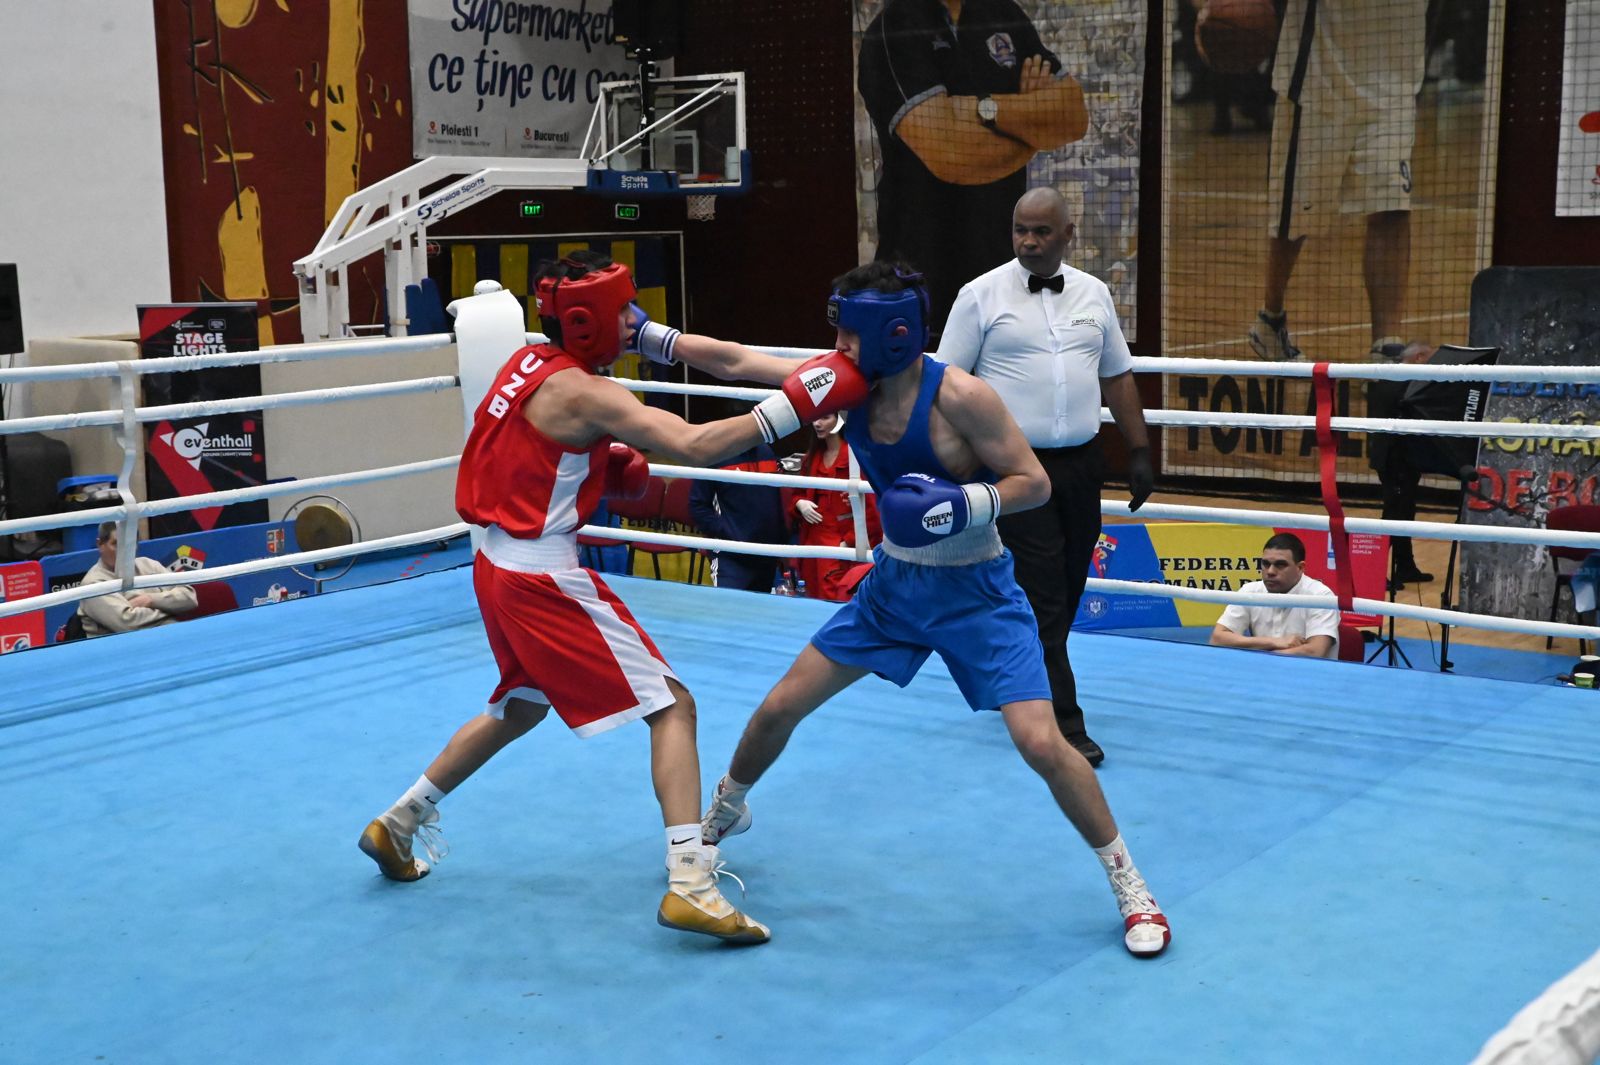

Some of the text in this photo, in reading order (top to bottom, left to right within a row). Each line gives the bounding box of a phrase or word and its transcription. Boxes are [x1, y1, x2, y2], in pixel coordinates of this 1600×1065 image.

[428, 53, 464, 92] ce
[474, 49, 533, 112] ține
[542, 65, 576, 103] cu
[461, 177, 485, 193] Sports
[524, 205, 541, 215] EXIT
[175, 333, 224, 344] STAGE
[173, 344, 227, 356] LIGHTS
[804, 370, 834, 387] GREEN
[807, 378, 833, 393] HILL
[1179, 374, 1285, 455] TONI
[184, 434, 252, 448] eventhall
[1466, 466, 1535, 513] DE
[923, 512, 952, 522] GREEN
[926, 518, 952, 528] HILL
[1159, 557, 1264, 575] FEDERAȚ
